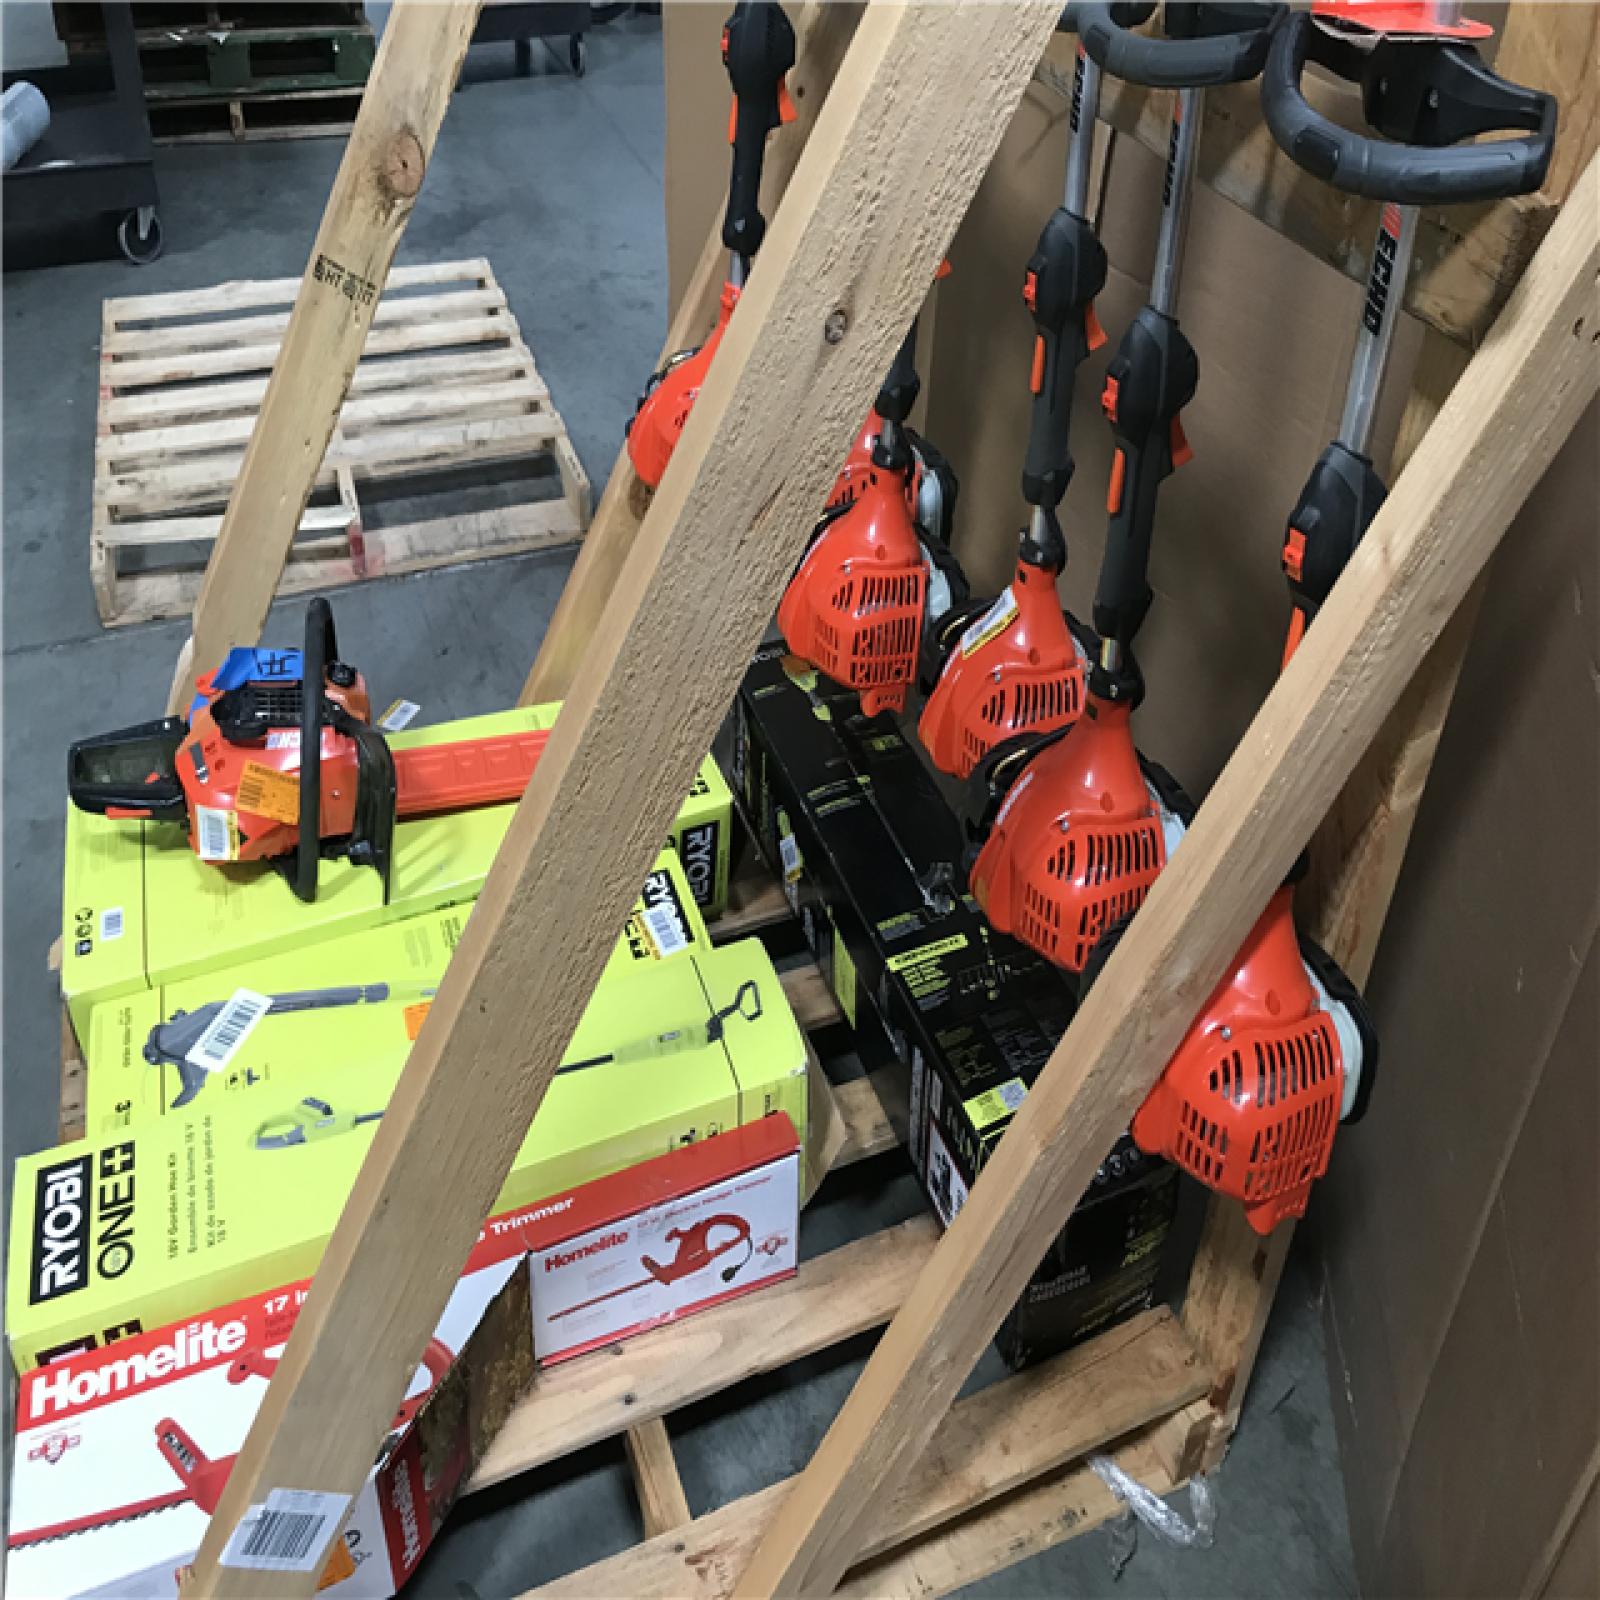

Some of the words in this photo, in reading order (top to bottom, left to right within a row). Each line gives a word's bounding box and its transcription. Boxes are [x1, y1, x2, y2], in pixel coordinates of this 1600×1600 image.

[1364, 229, 1398, 337] ECHO
[40, 1162, 83, 1296] RYOBI
[490, 1197, 574, 1231] Trimmer
[544, 1231, 629, 1272] Homelite
[263, 1295, 288, 1315] 17
[29, 1318, 247, 1417] Homelite
